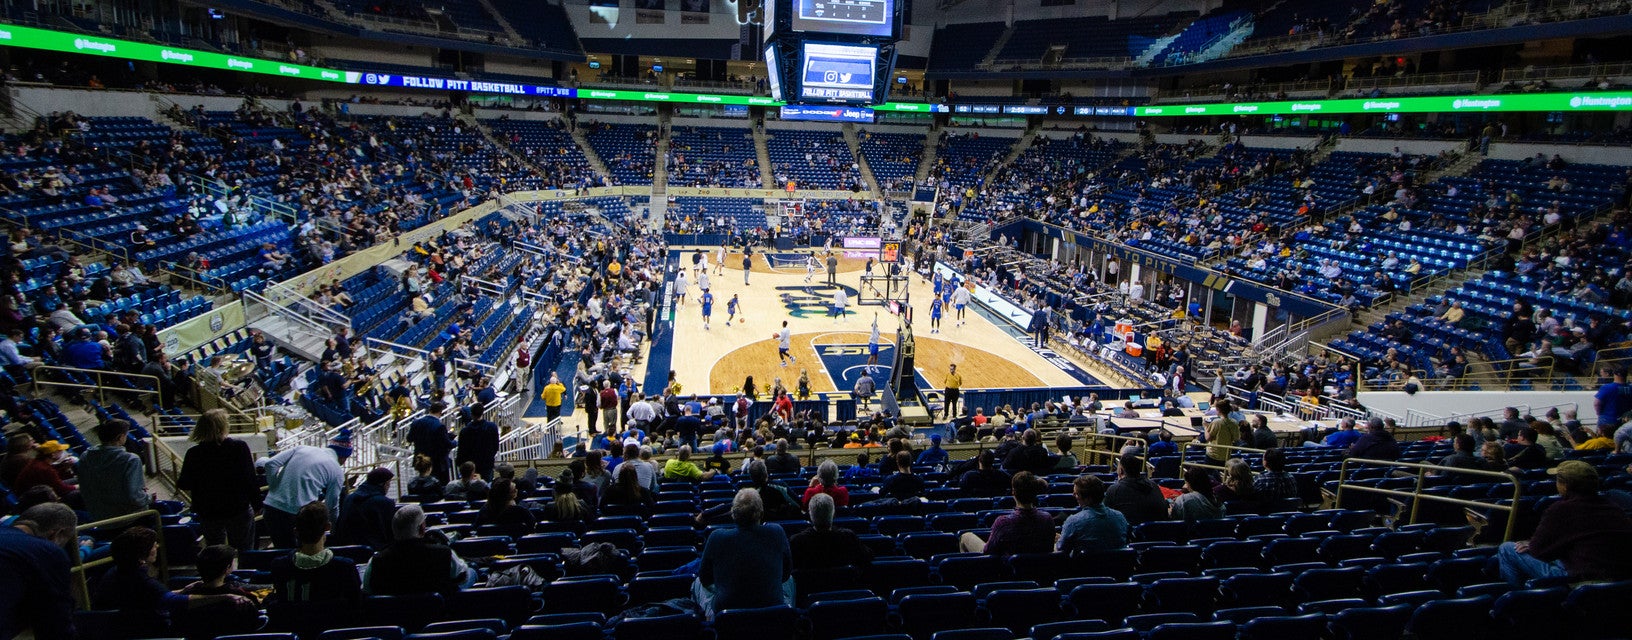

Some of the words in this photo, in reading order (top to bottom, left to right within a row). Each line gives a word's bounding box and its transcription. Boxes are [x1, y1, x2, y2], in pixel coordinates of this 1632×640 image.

[402, 76, 444, 89] FOLLOW
[447, 79, 468, 90] PITT
[471, 82, 526, 94] BASKETBALL
[802, 87, 824, 97] FOLLOW
[824, 88, 838, 98] PITT
[838, 89, 872, 99] BASKETBALL
[1462, 99, 1500, 109] Huntington
[1582, 96, 1632, 108] Huntington
[843, 109, 860, 119] Jeep
[1093, 242, 1119, 257] HAIL
[1124, 252, 1140, 263] TO
[1145, 256, 1177, 274] PITT
